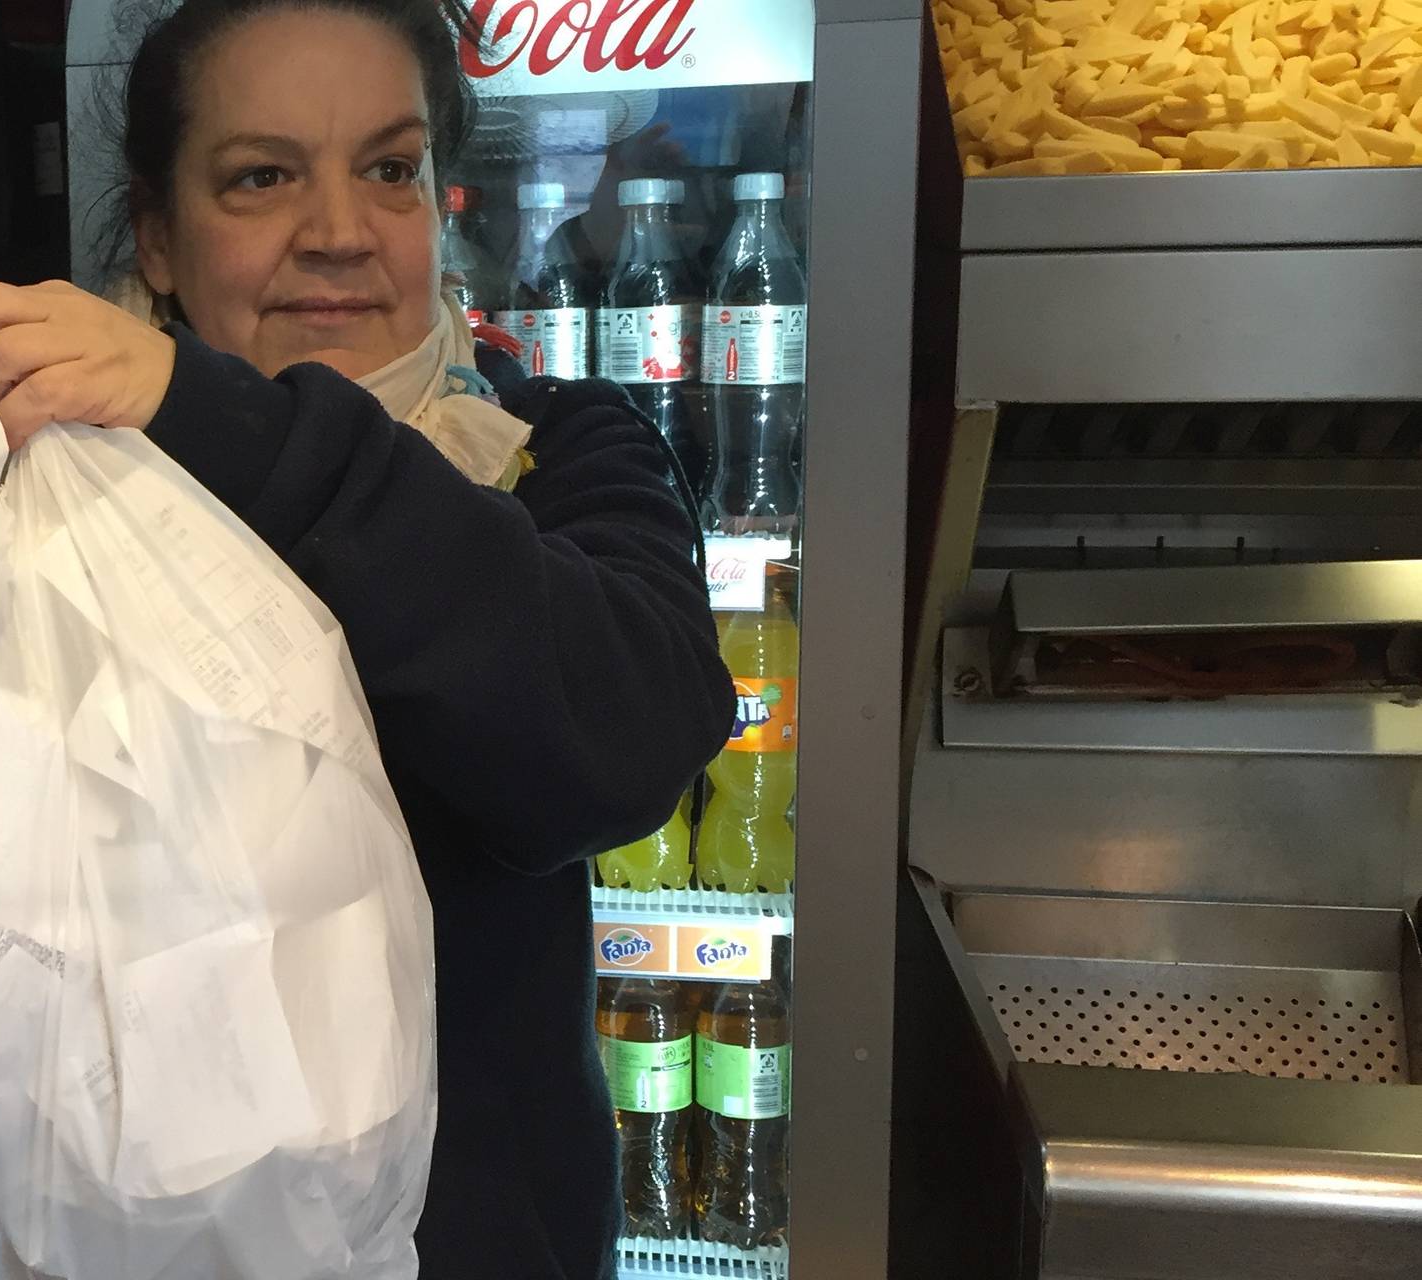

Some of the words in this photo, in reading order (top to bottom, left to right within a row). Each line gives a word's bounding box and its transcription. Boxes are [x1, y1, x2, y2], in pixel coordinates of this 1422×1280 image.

[457, 0, 696, 78] Cola
[736, 696, 770, 721] NTA
[600, 937, 652, 962] Fanta
[696, 942, 748, 966] Fanta
